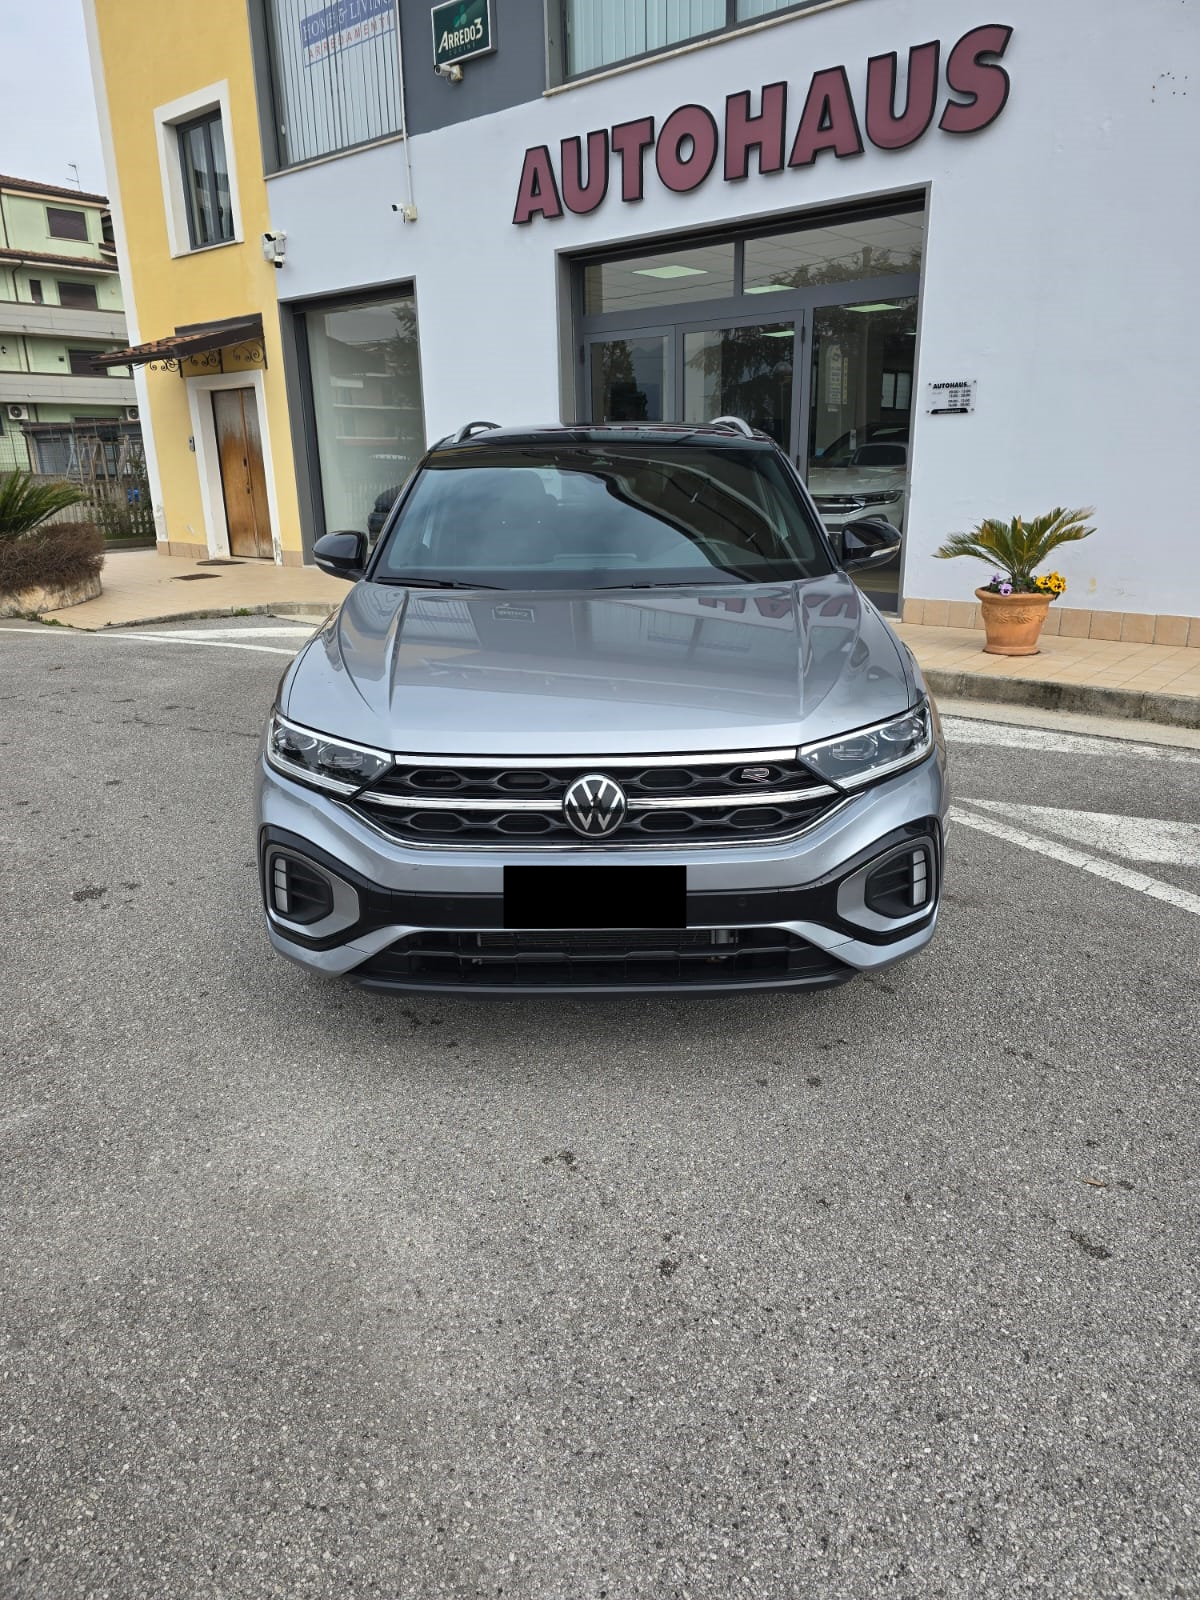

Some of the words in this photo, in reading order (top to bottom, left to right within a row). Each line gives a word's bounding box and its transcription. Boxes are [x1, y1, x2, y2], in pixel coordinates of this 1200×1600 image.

[303, 11, 337, 41] HOME
[438, 17, 483, 54] ARREDO3
[512, 23, 1013, 225] AUTOHAUS
[933, 381, 968, 389] AUTOHAUS
